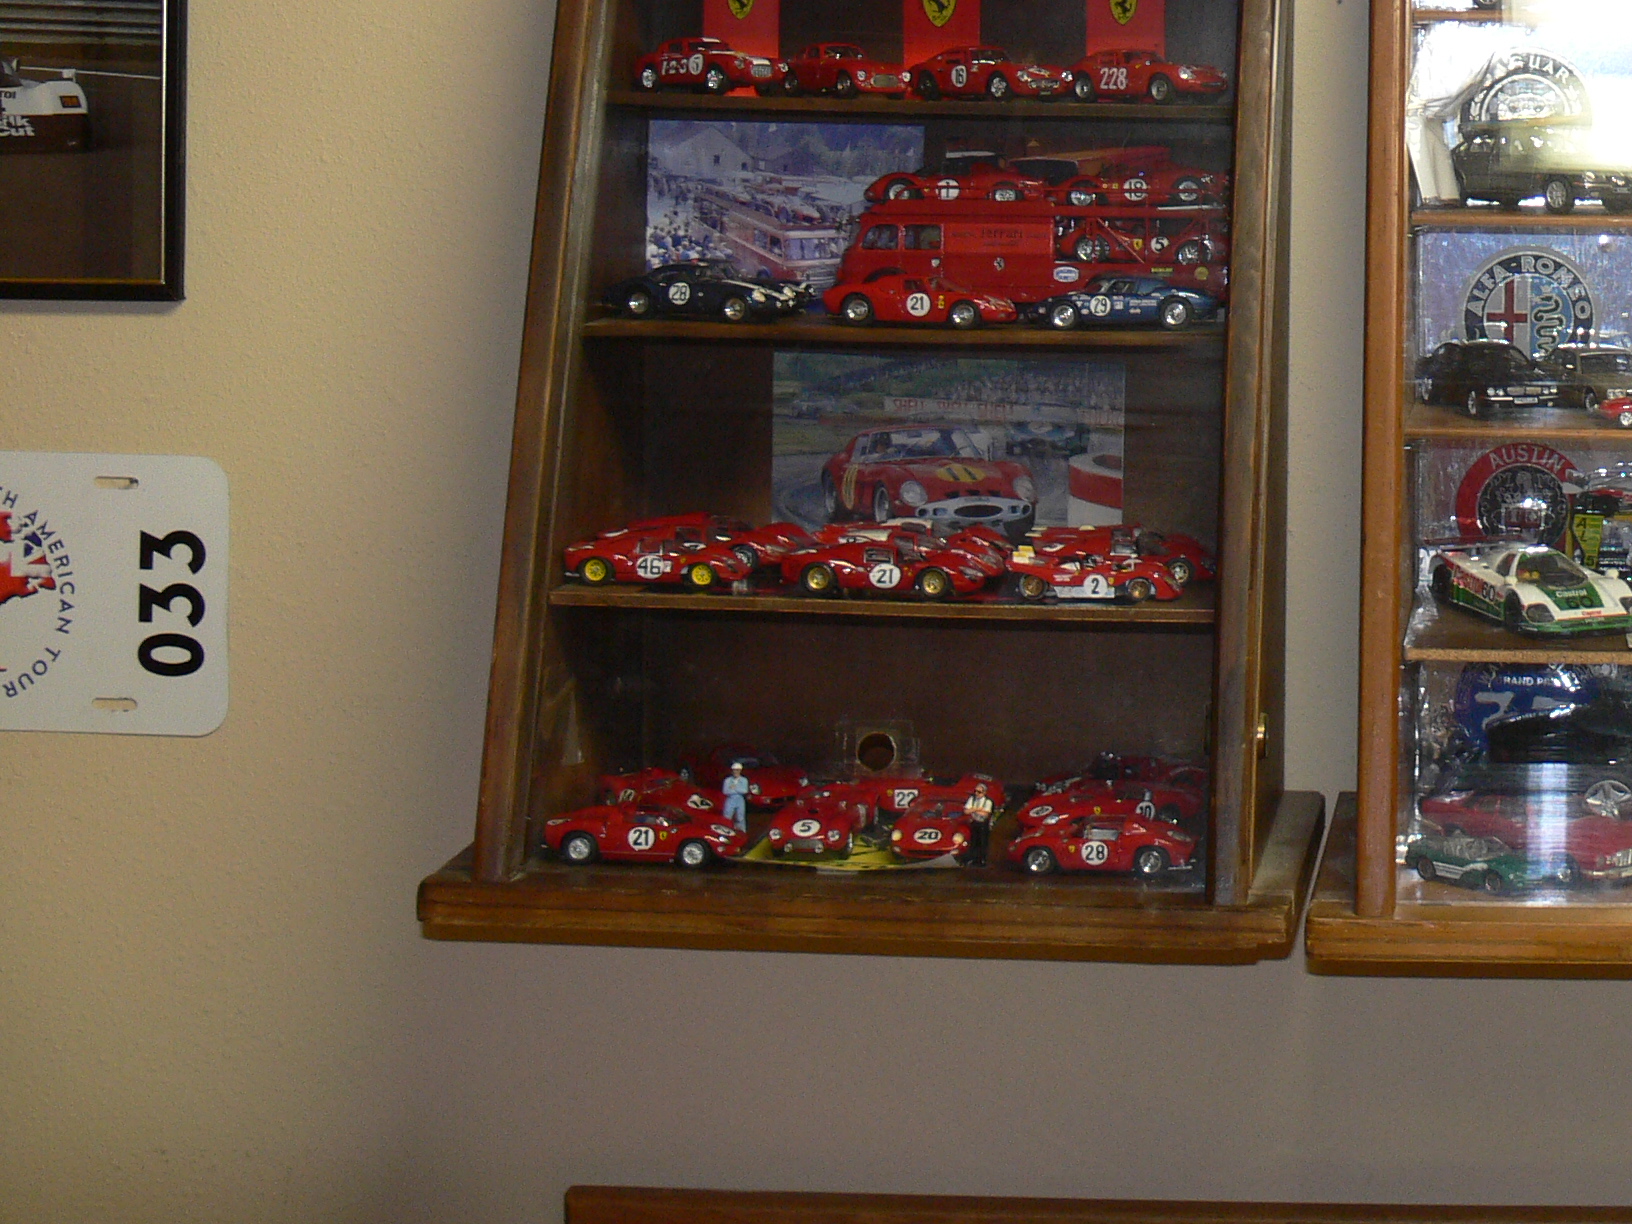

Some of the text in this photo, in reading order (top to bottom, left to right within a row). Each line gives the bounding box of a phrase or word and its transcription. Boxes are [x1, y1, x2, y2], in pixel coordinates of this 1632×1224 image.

[1100, 67, 1129, 91] 228
[1154, 237, 1166, 252] 5
[671, 285, 688, 304] 28
[909, 295, 927, 313] 21
[1092, 297, 1109, 314] 29
[1489, 444, 1567, 475] AUSTIN
[23, 509, 76, 635] AMERICAN
[637, 557, 662, 576] 46
[875, 568, 893, 585] 21
[1091, 577, 1100, 594] 2
[137, 529, 207, 678] 033
[1, 646, 62, 699] TOUR
[1499, 676, 1535, 687] GRAND
[797, 821, 815, 834] 5
[916, 830, 940, 841] 20
[632, 829, 650, 846] 21
[1084, 843, 1105, 861] 28
